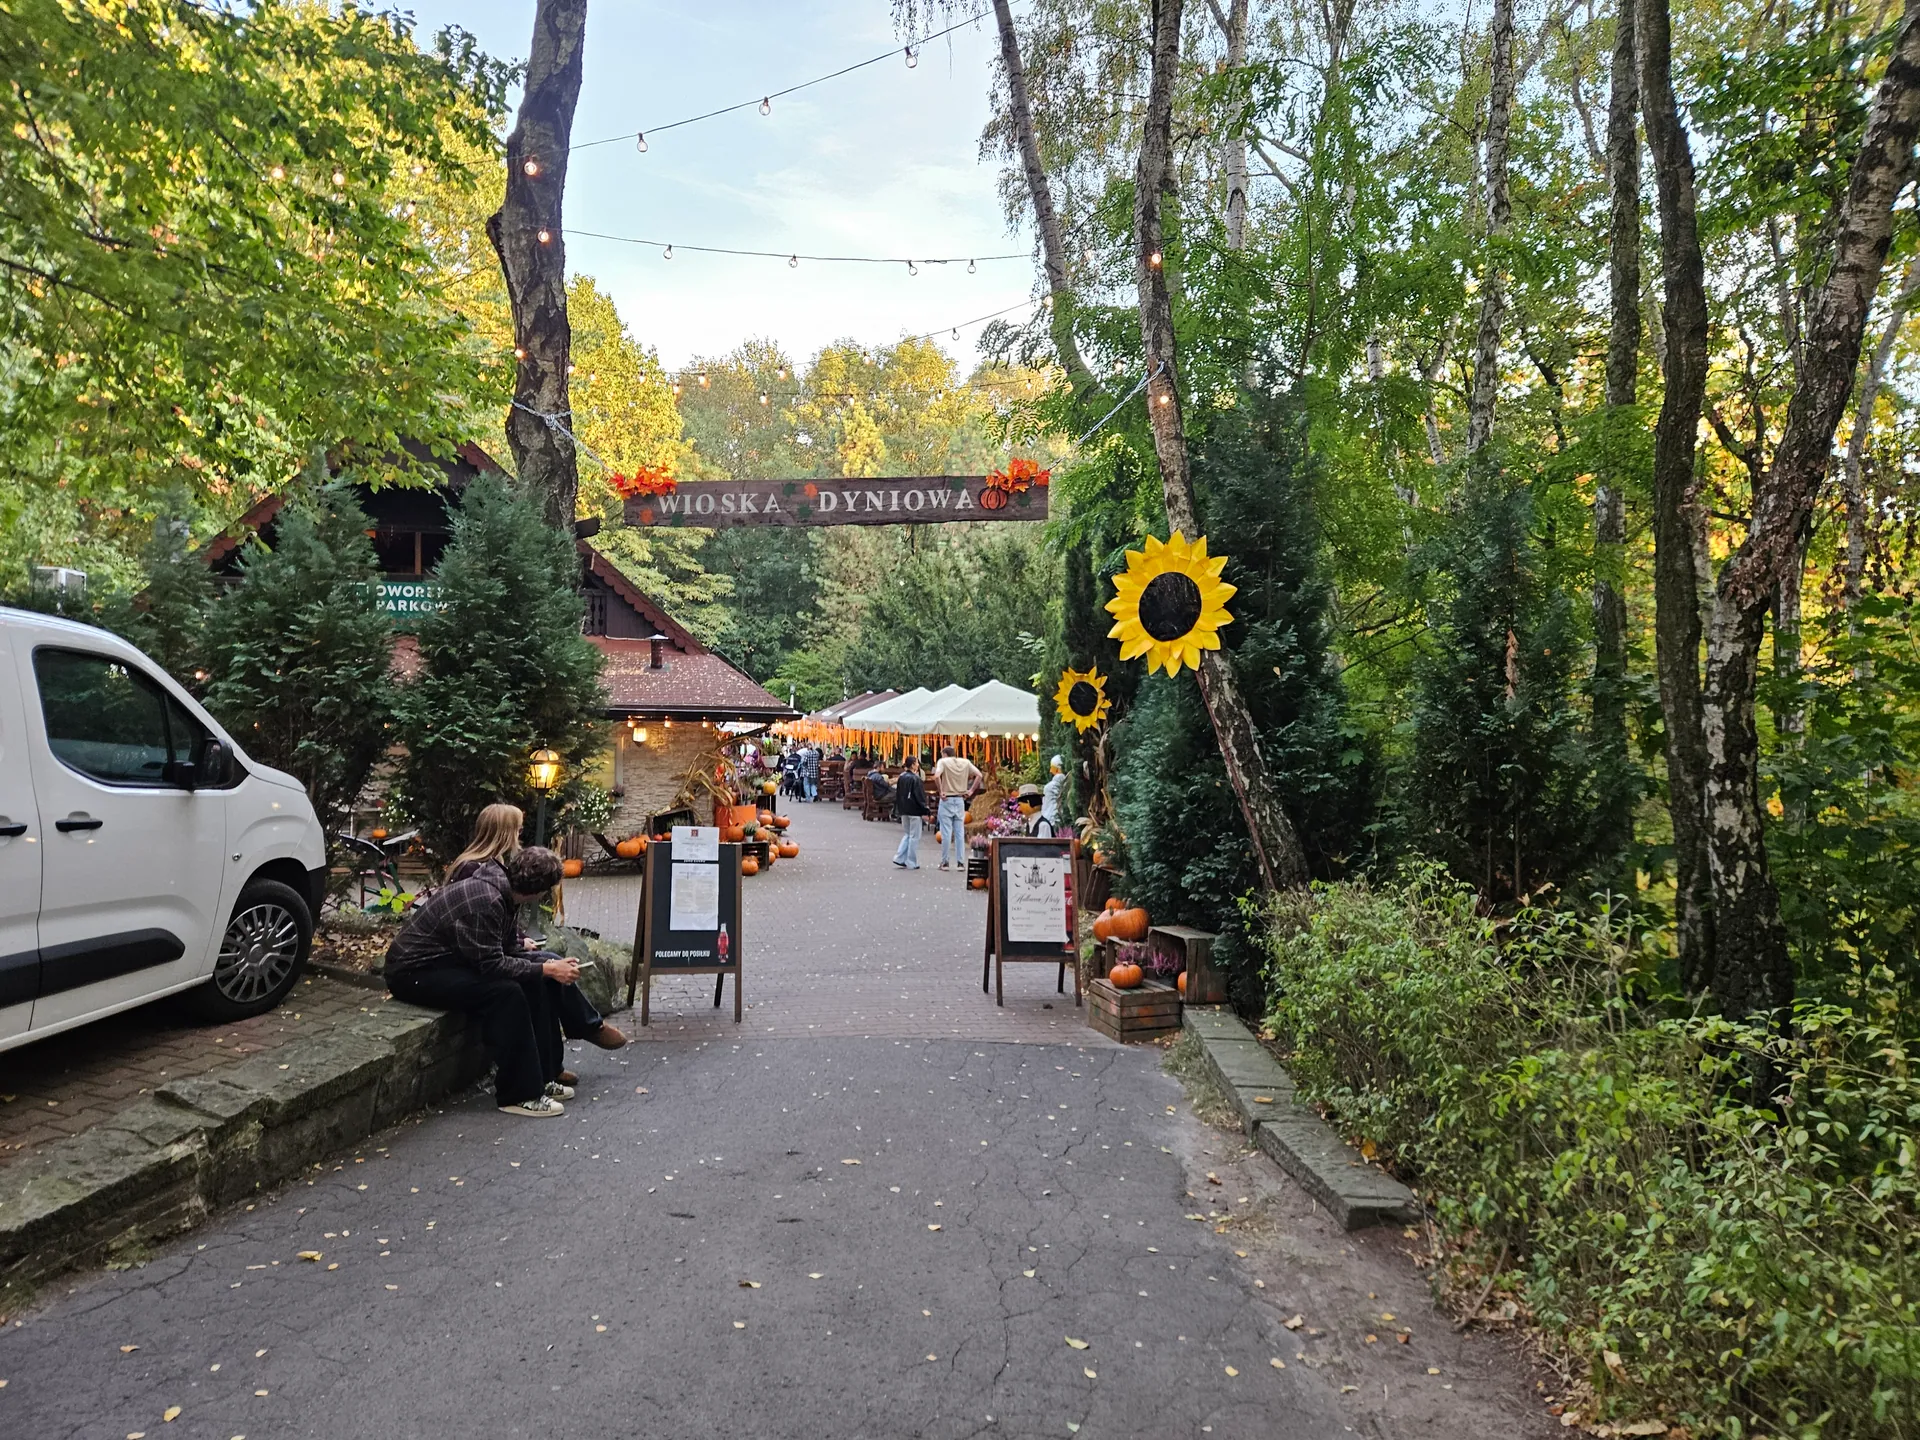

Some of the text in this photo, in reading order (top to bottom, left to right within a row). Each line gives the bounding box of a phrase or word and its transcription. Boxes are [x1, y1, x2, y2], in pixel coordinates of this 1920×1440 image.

[658, 488, 975, 515] WIOSKA DYNIOWA
[375, 599, 449, 612] PARKOW
[655, 950, 681, 958] POLECAMY
[681, 950, 690, 958] DO
